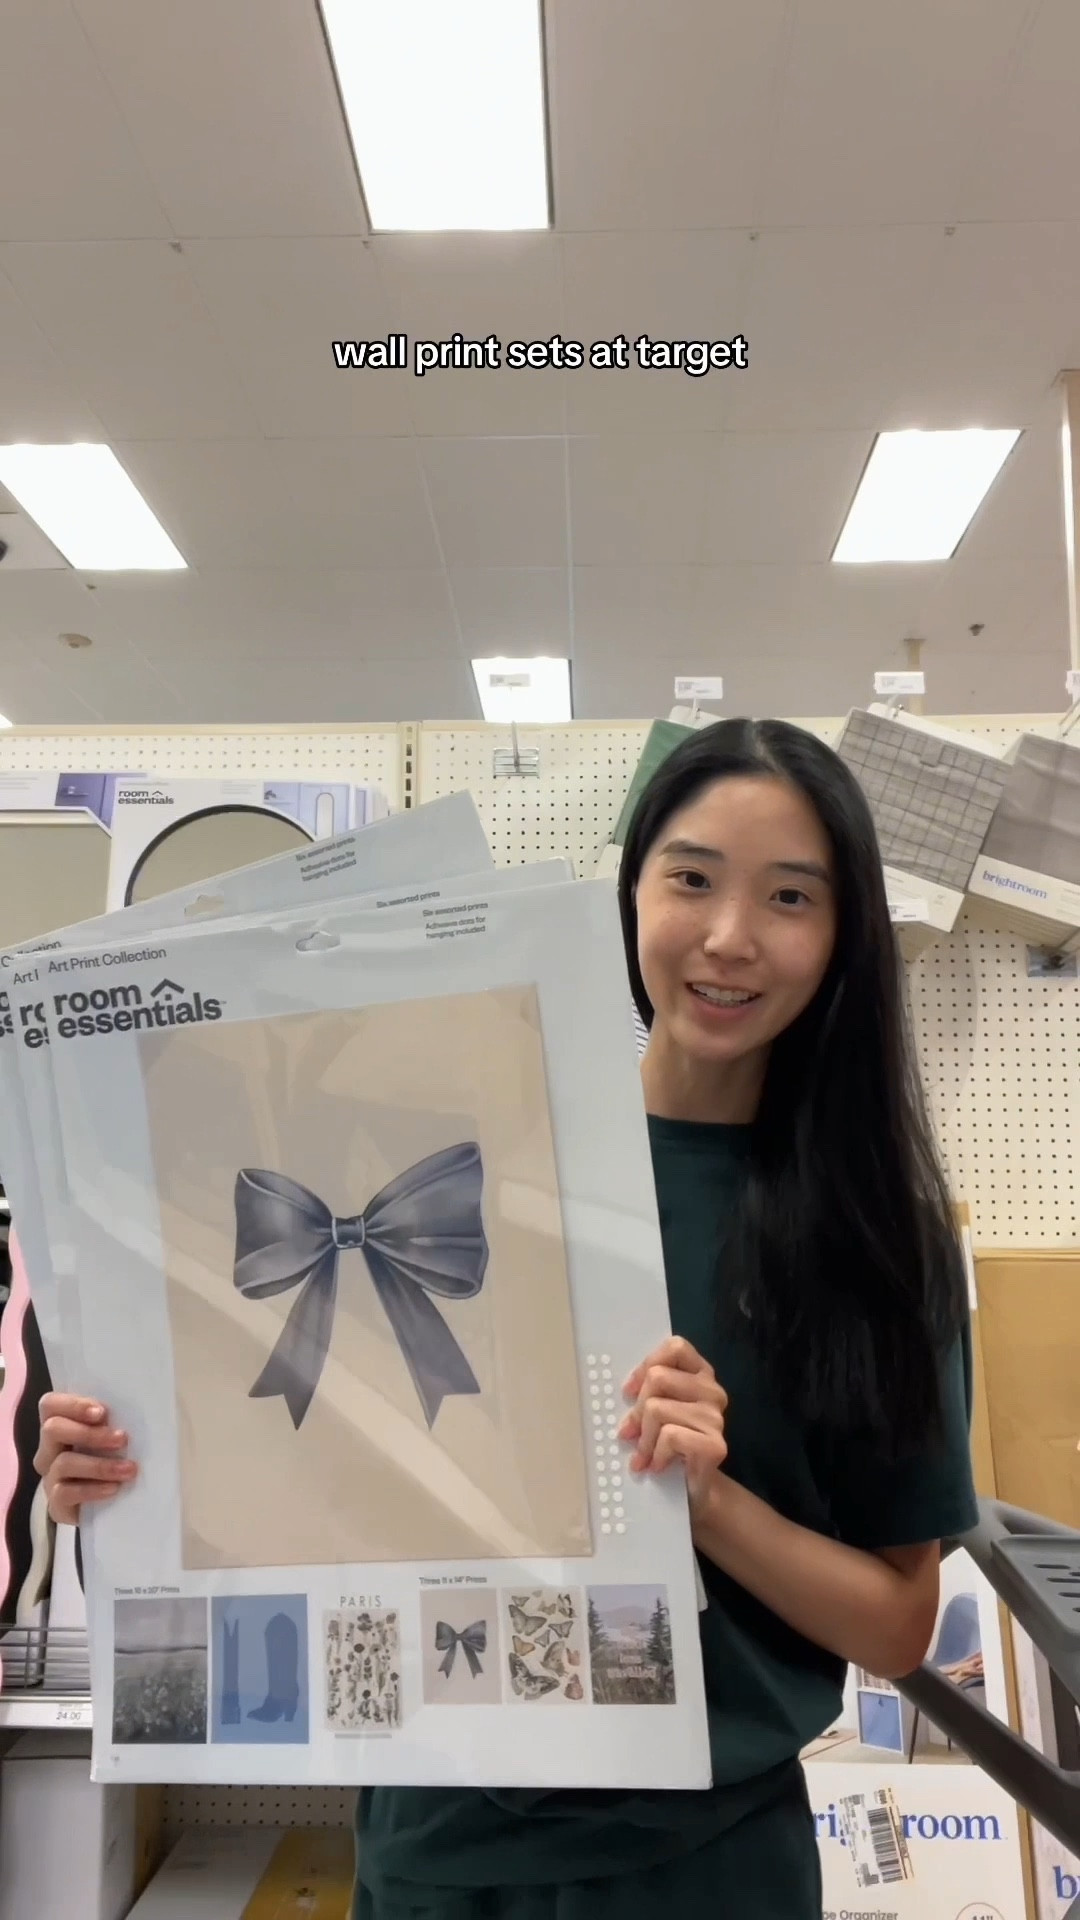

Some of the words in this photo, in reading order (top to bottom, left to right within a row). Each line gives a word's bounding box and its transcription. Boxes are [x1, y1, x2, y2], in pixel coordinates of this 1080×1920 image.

[118, 796, 174, 804] essentials
[982, 870, 1048, 899] brightroom
[420, 891, 440, 901] prints
[467, 902, 488, 912] prints
[48, 960, 69, 973] Art
[70, 957, 100, 970] Print
[102, 947, 167, 966] Collection
[13, 972, 33, 985] Art
[53, 984, 142, 1015] room
[57, 992, 223, 1039] essentials
[340, 1595, 382, 1608] PARIS
